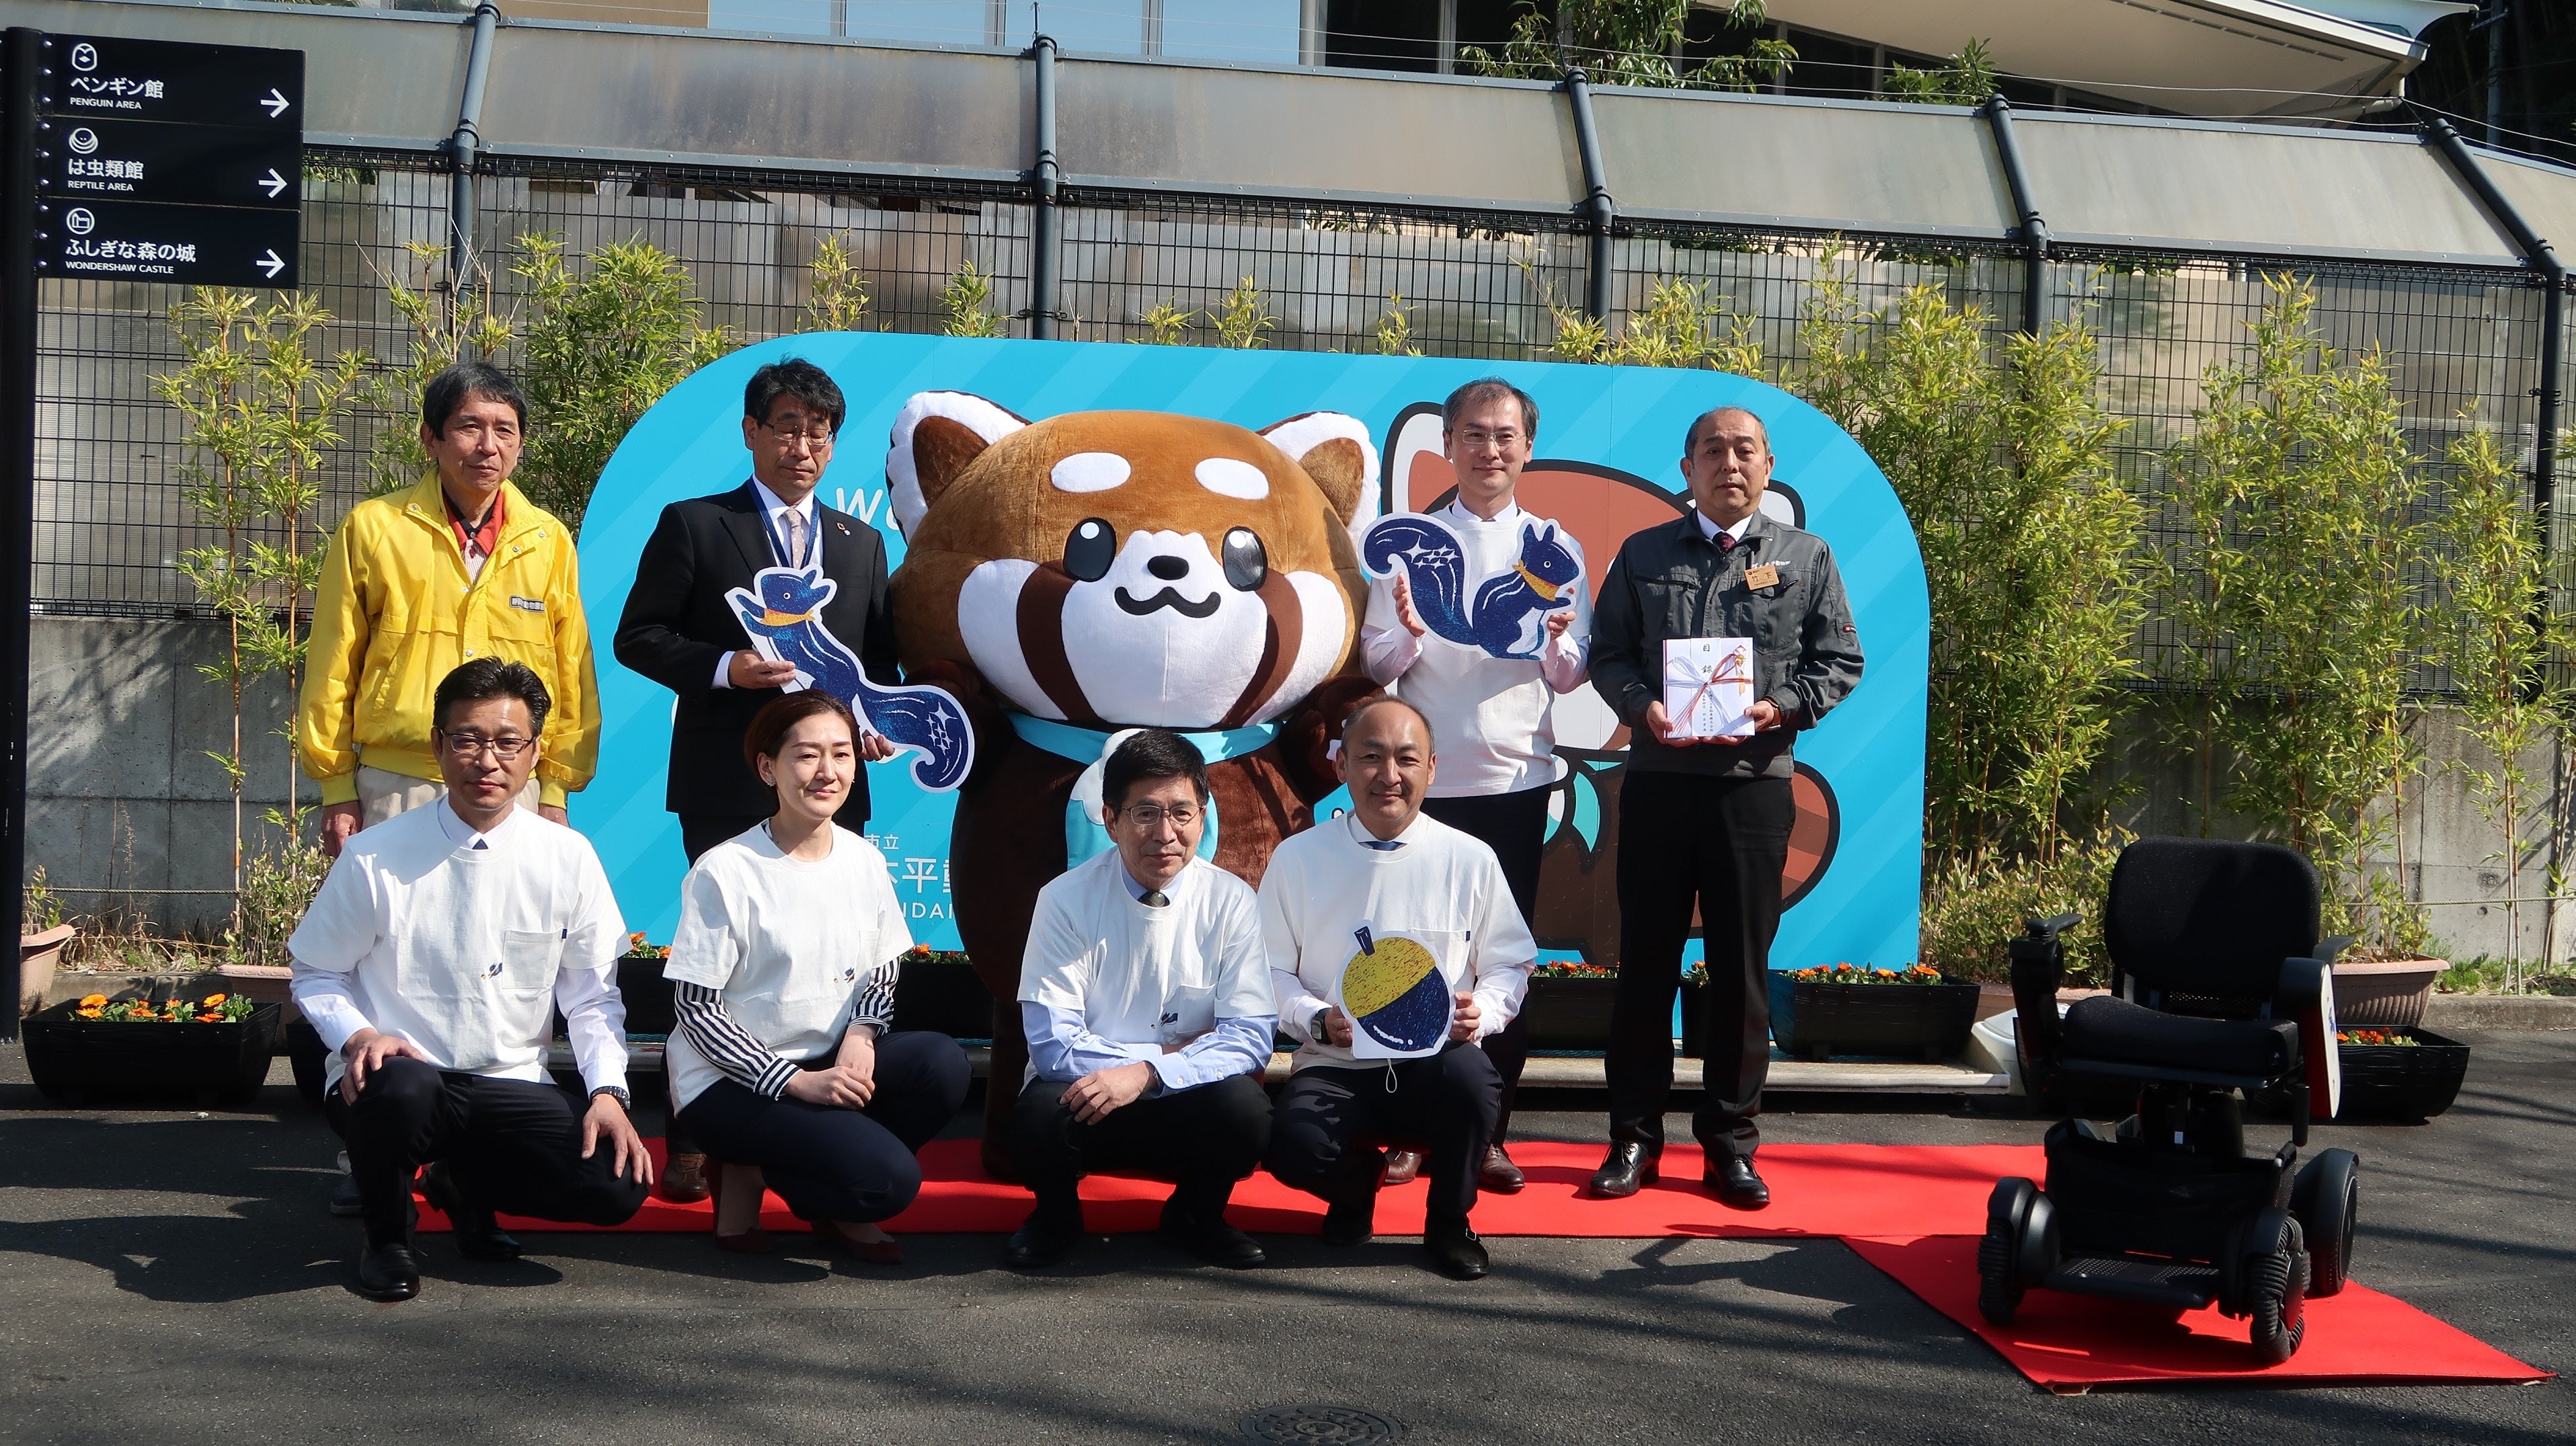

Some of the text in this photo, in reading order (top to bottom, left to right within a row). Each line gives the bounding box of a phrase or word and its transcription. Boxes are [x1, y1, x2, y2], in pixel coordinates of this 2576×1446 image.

[71, 77, 163, 98] ペンギン館
[71, 97, 142, 110] PENGUIN AREA
[69, 158, 143, 179] は虫類館
[68, 180, 134, 192] REPTILE AREA
[66, 239, 196, 262] ふしぎな森の城
[66, 261, 174, 274] WONDERSHAW CASTLE
